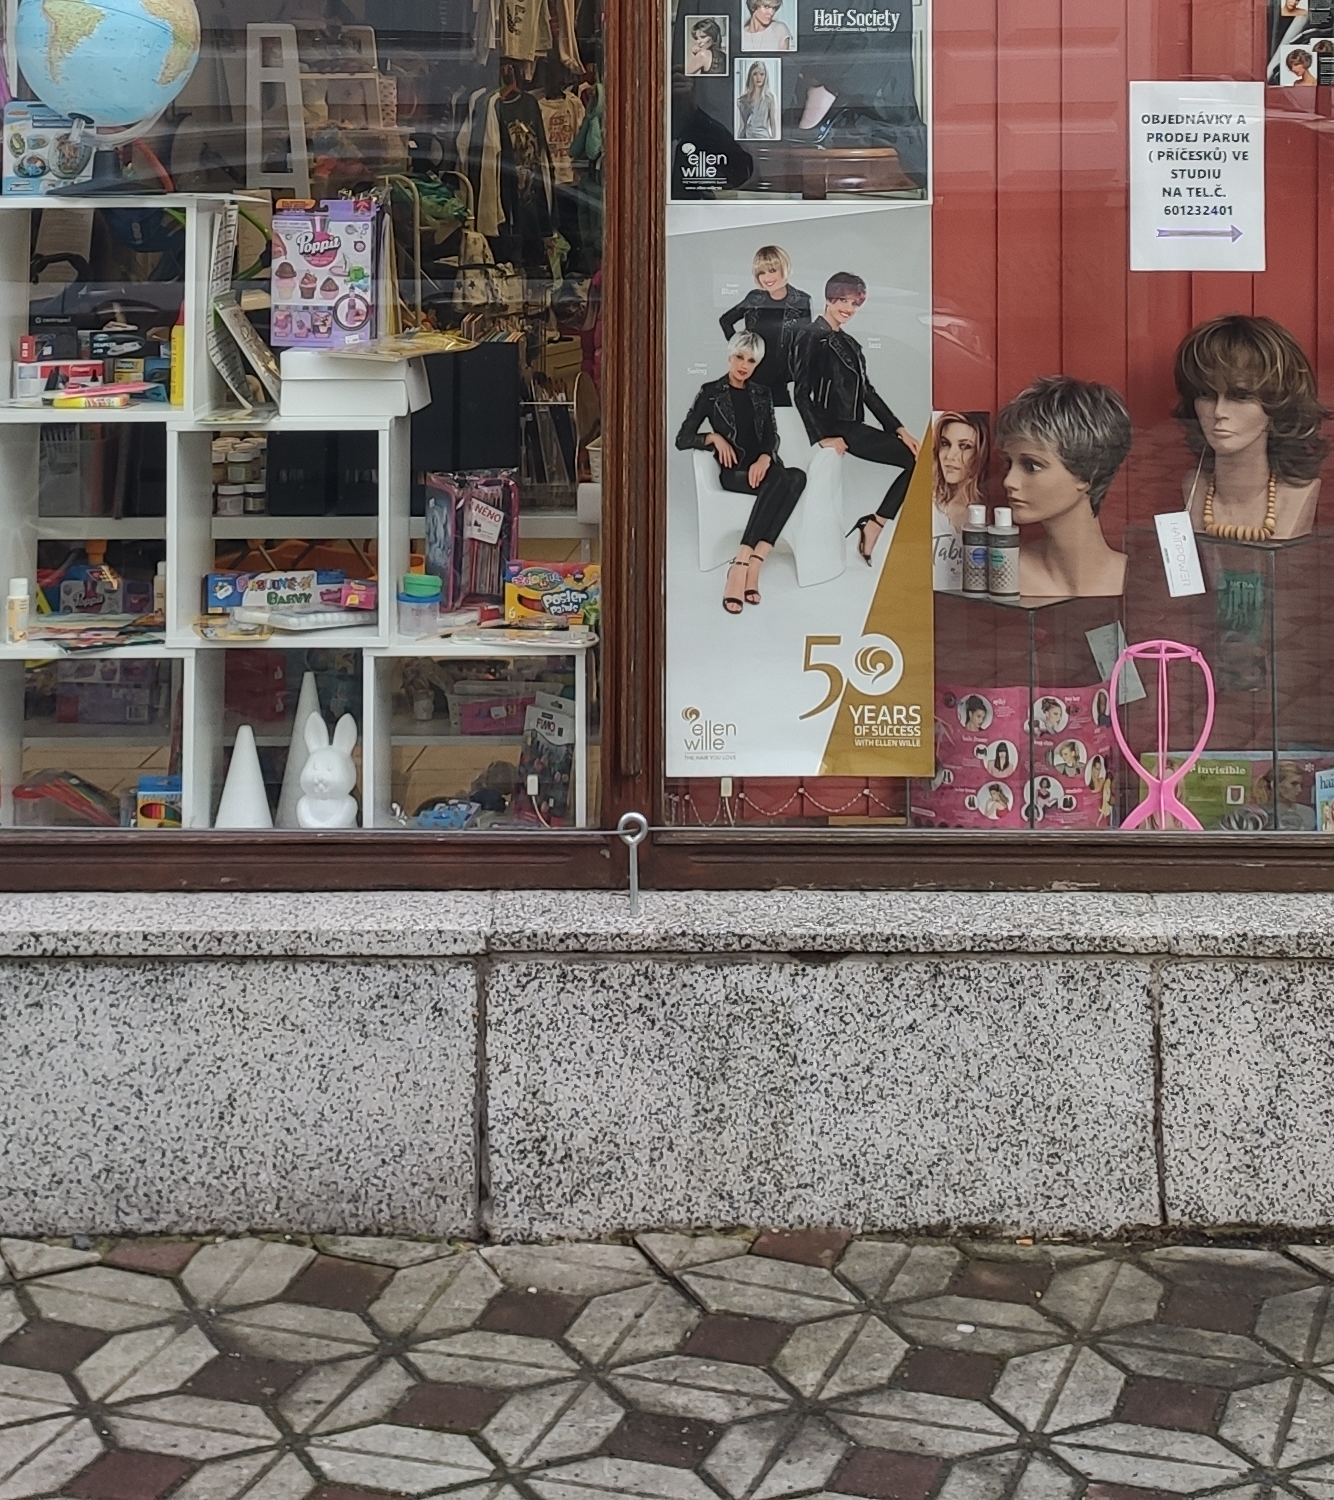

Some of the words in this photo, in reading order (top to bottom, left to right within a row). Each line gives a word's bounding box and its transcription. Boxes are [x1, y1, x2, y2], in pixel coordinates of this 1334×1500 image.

[813, 9, 844, 26] Hair
[846, 9, 901, 32] Society
[1141, 111, 1233, 125] OBJEDNÁVKY
[1236, 114, 1246, 125] A
[1146, 132, 1198, 143] PRODEJ
[1203, 132, 1250, 143] PARUK
[688, 150, 728, 165] ellen
[1232, 150, 1249, 161] VE
[680, 163, 717, 178] wille
[1170, 169, 1222, 179] STUDIU
[1162, 187, 1183, 198] NA
[1164, 205, 1233, 216] 601232401
[296, 231, 342, 255] Poppit
[849, 704, 921, 725] YEARS
[692, 719, 737, 736] ellen
[854, 725, 870, 736] OF
[871, 725, 921, 736] SUCCESS
[683, 735, 725, 751] wille
[854, 739, 874, 747] WITH
[875, 739, 898, 747] ELLEN
[898, 739, 921, 747] WILLE
